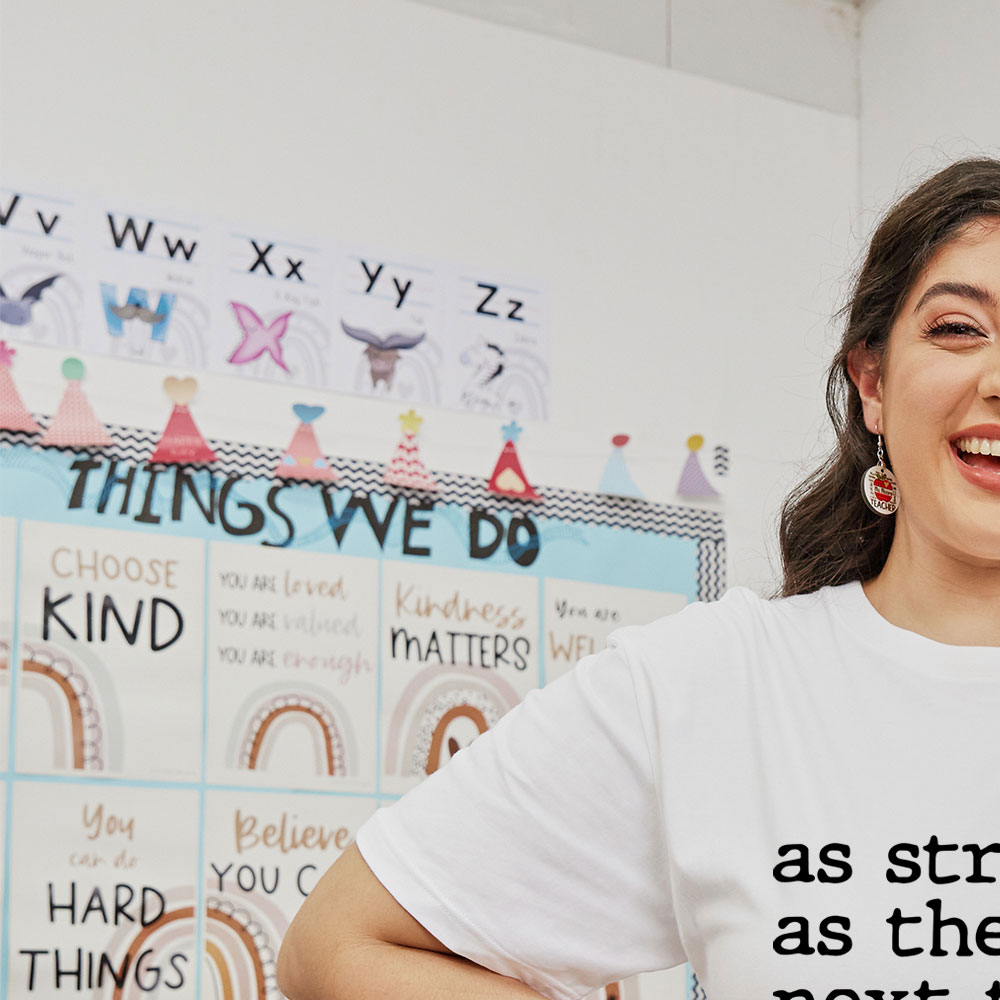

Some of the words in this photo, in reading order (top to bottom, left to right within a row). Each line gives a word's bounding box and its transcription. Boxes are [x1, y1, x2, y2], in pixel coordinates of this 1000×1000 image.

[68, 461, 296, 549] THINGS
[321, 488, 432, 557] WE
[468, 507, 541, 568] DO
[51, 547, 179, 590] CHOOSE
[219, 571, 248, 591] YOU
[252, 574, 277, 593] ARE
[283, 569, 347, 601] loved
[42, 586, 184, 652] KIND
[218, 608, 248, 628] YOU
[252, 612, 277, 632] ARE
[396, 582, 528, 630] Kindness
[217, 646, 247, 666] YOU
[252, 650, 276, 669] ARE
[390, 625, 531, 671] MATTERS
[82, 802, 135, 841] You
[234, 809, 350, 854] Believe
[210, 862, 279, 895] YOU
[297, 864, 318, 897] C
[773, 843, 853, 884] as
[48, 881, 166, 928] HARD
[773, 916, 853, 957] as
[19, 948, 188, 992] THINGS
